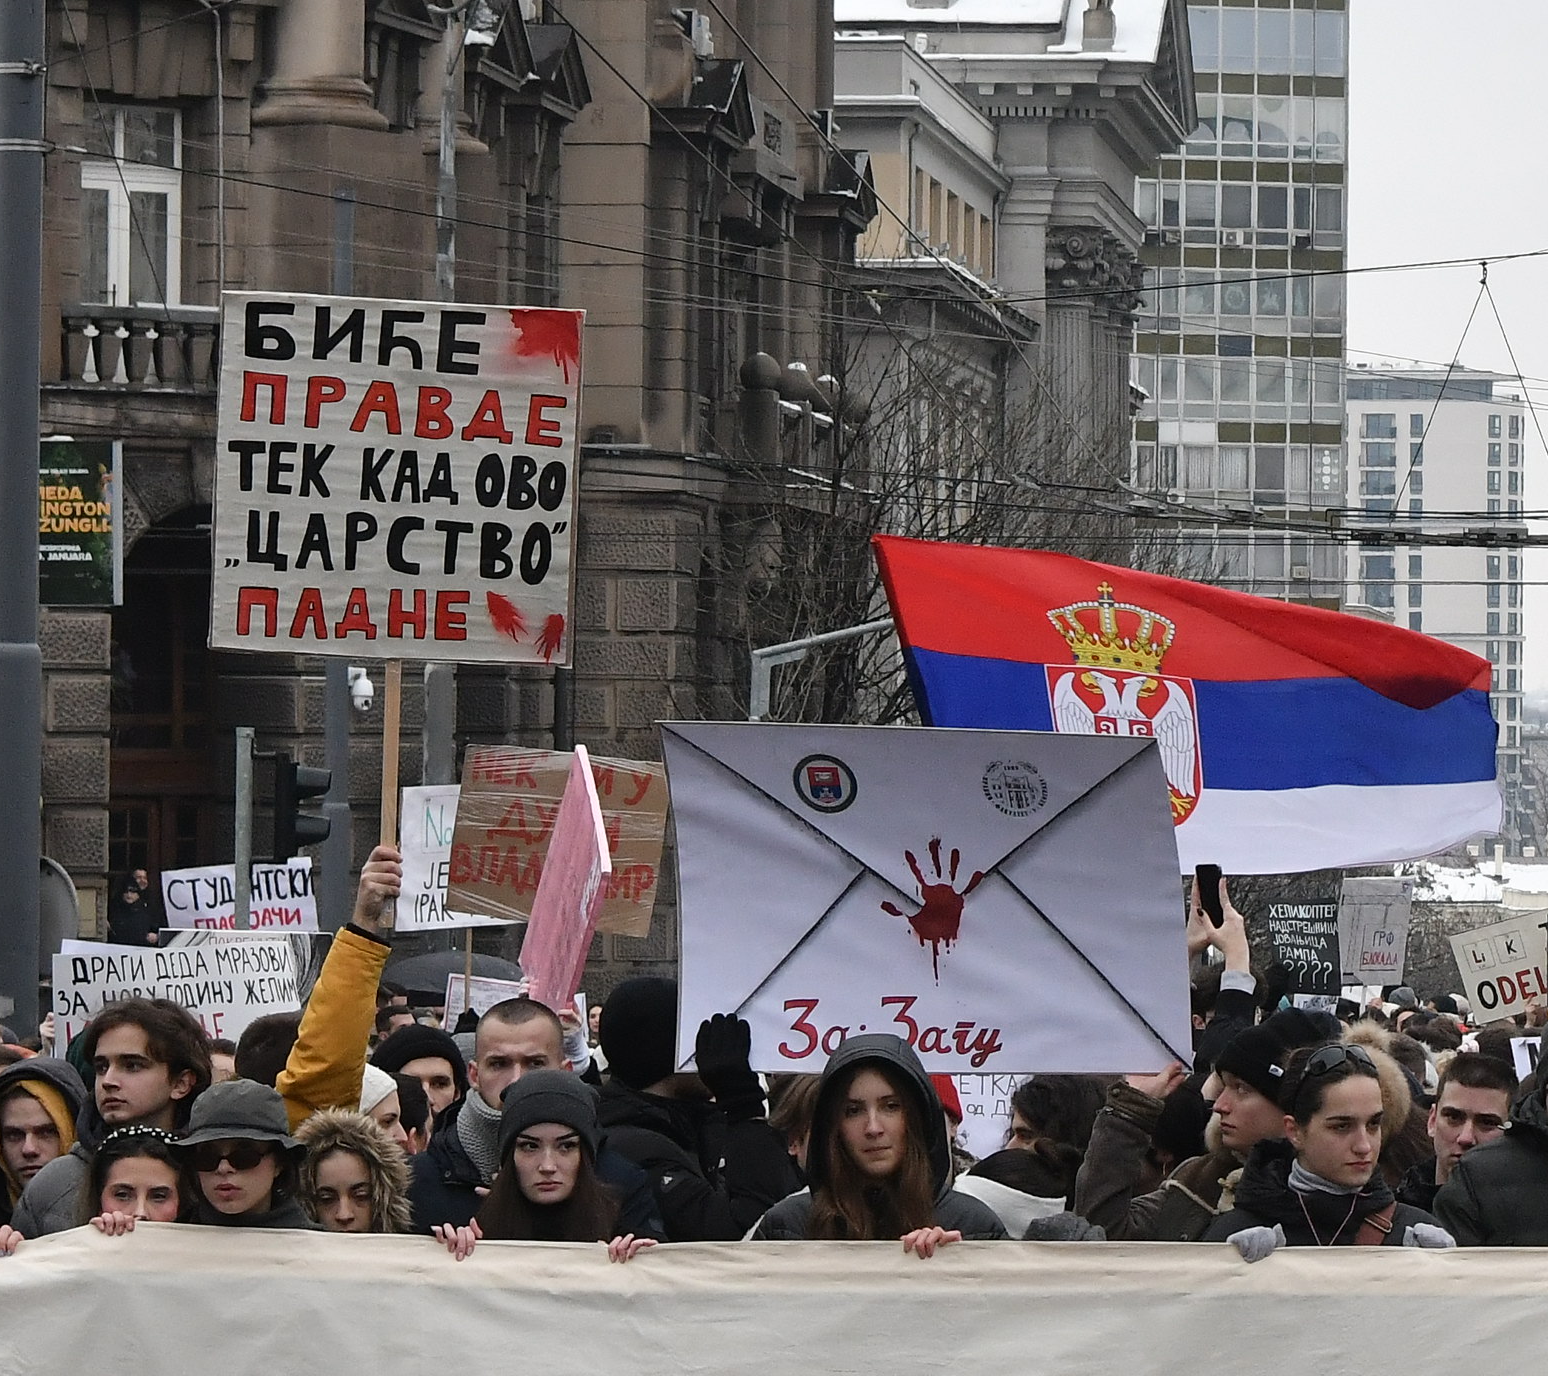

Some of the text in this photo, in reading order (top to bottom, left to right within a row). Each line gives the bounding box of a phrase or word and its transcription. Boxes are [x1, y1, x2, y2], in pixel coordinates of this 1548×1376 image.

[244, 302, 487, 375] БИЋЕ
[239, 371, 567, 448] ПРАВДЕ
[228, 440, 567, 512] ТЕК КАД ОВО
[236, 586, 470, 641] ПАДНЕ
[167, 867, 315, 911] СТУДНТСКИ
[72, 945, 292, 985] ДРАГИ ДЕДА МРАЗОВИ
[1279, 946, 1318, 961] РАМПА
[58, 990, 89, 1017] ЗА
[166, 979, 233, 1010] ГОДИНУ
